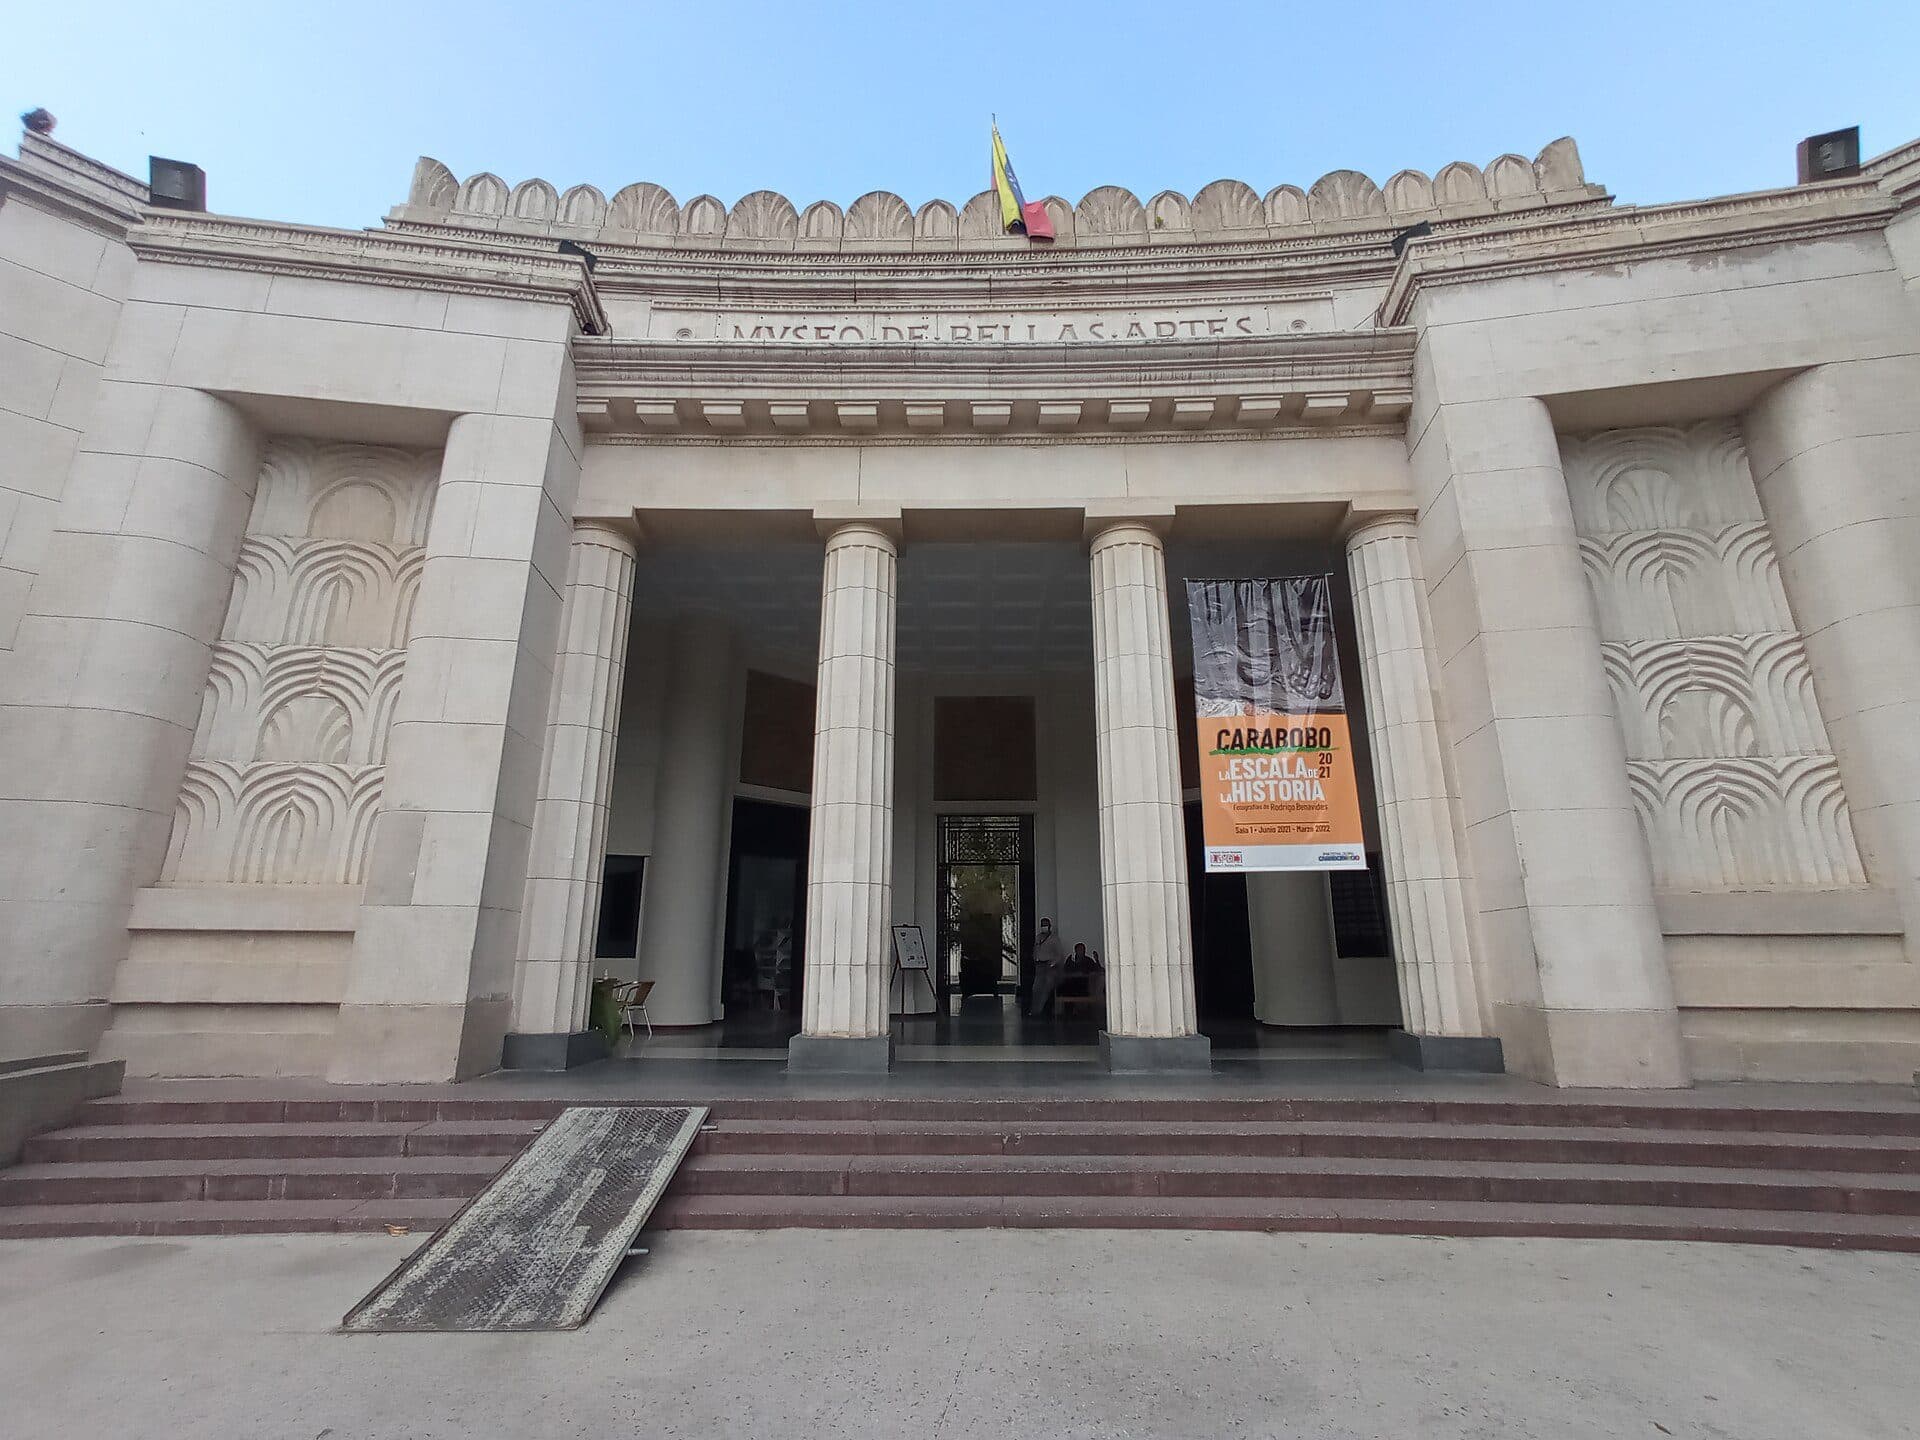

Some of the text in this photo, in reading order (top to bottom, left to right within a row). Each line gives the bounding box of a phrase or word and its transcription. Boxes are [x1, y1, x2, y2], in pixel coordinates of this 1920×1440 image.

[1216, 727, 1332, 750] CARABOBO
[1318, 752, 1333, 765] 20
[1218, 757, 1319, 781] LA ESCALA DE
[1319, 766, 1331, 779] 21
[1220, 779, 1326, 803] LA HISTORIA
[1270, 803, 1295, 812] Rodrigo
[1235, 826, 1249, 834] Sala
[1259, 826, 1276, 834] Junio
[1277, 825, 1291, 834] 2021
[1296, 825, 1314, 833] Marzo
[1315, 825, 1331, 833] 2022
